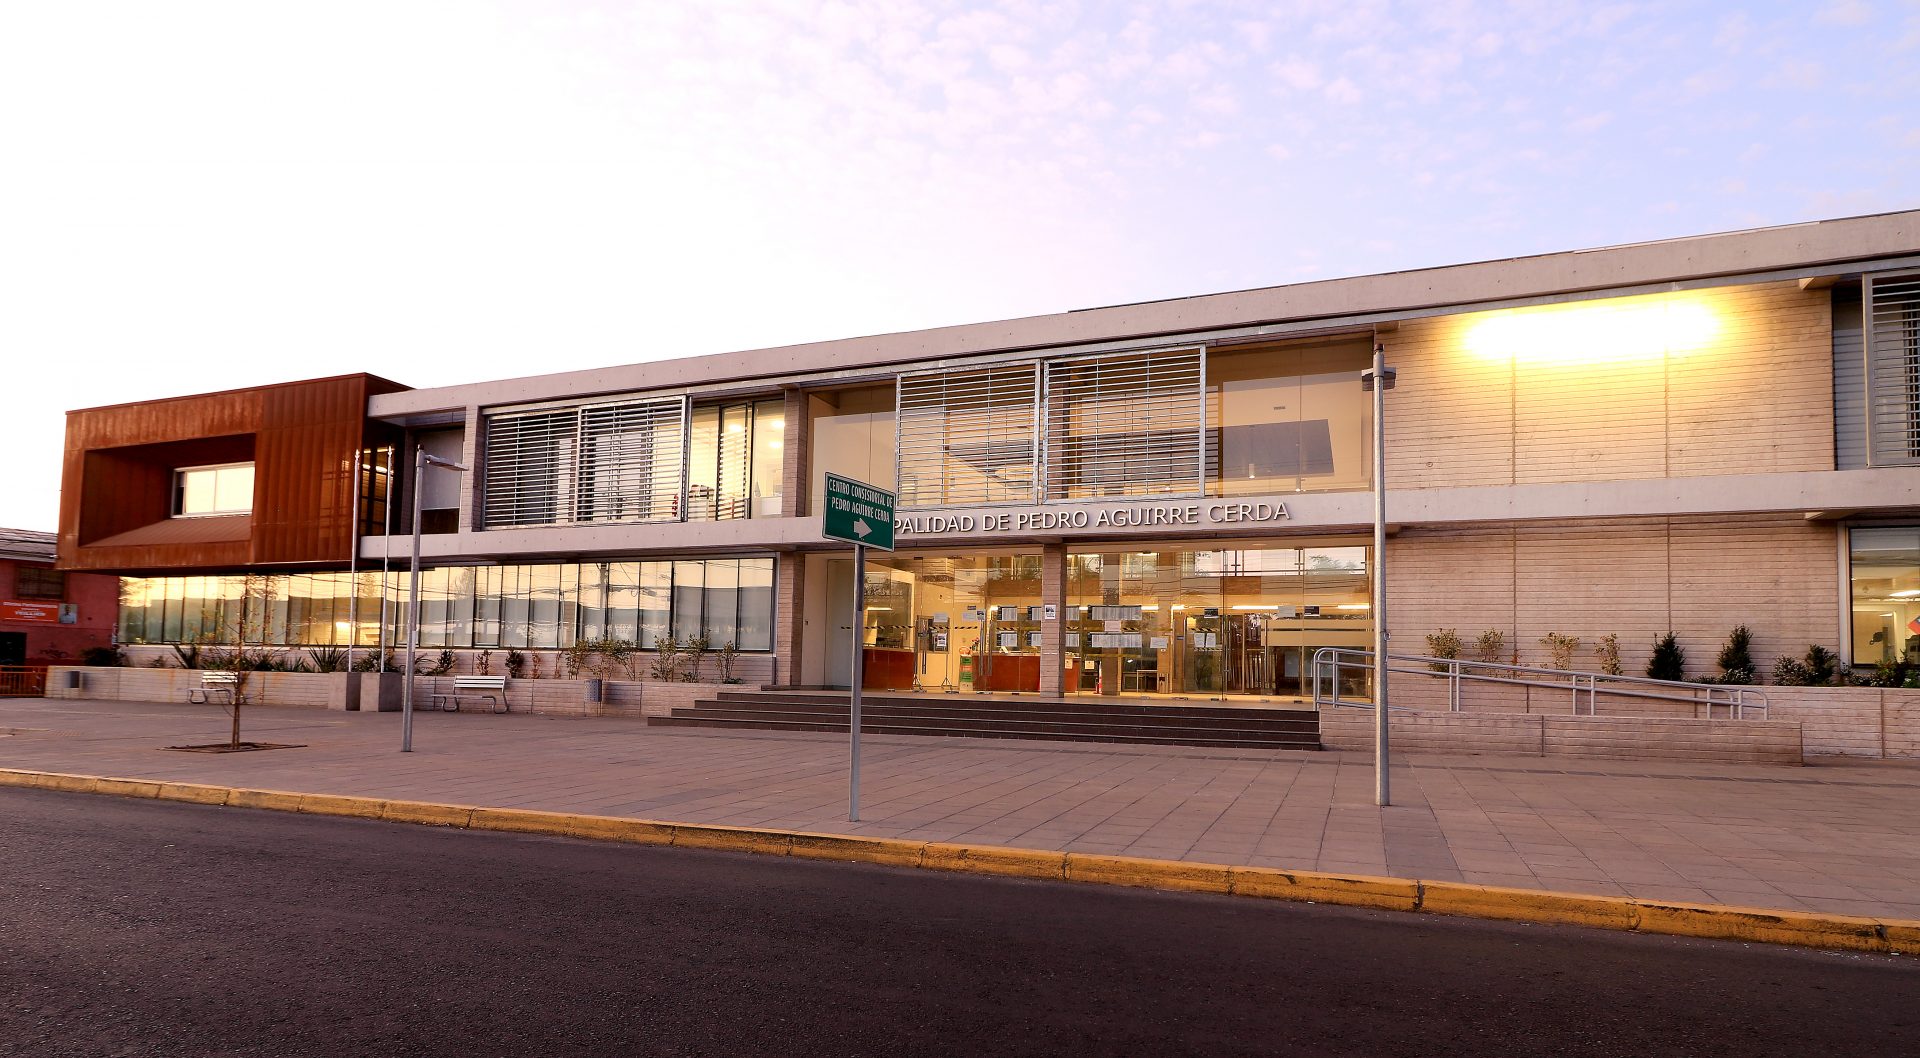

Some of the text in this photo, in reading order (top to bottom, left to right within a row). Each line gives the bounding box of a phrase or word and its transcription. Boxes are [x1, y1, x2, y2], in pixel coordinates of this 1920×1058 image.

[829, 479, 893, 508] CENTRO CONSISTORIAL DE
[831, 496, 890, 523] PEDRO AGUIRRE CERDA
[982, 514, 1009, 532] DE
[1017, 510, 1088, 530] PEDRO
[1096, 505, 1199, 527] AGUIRRE
[1208, 502, 1291, 523] CERDA
